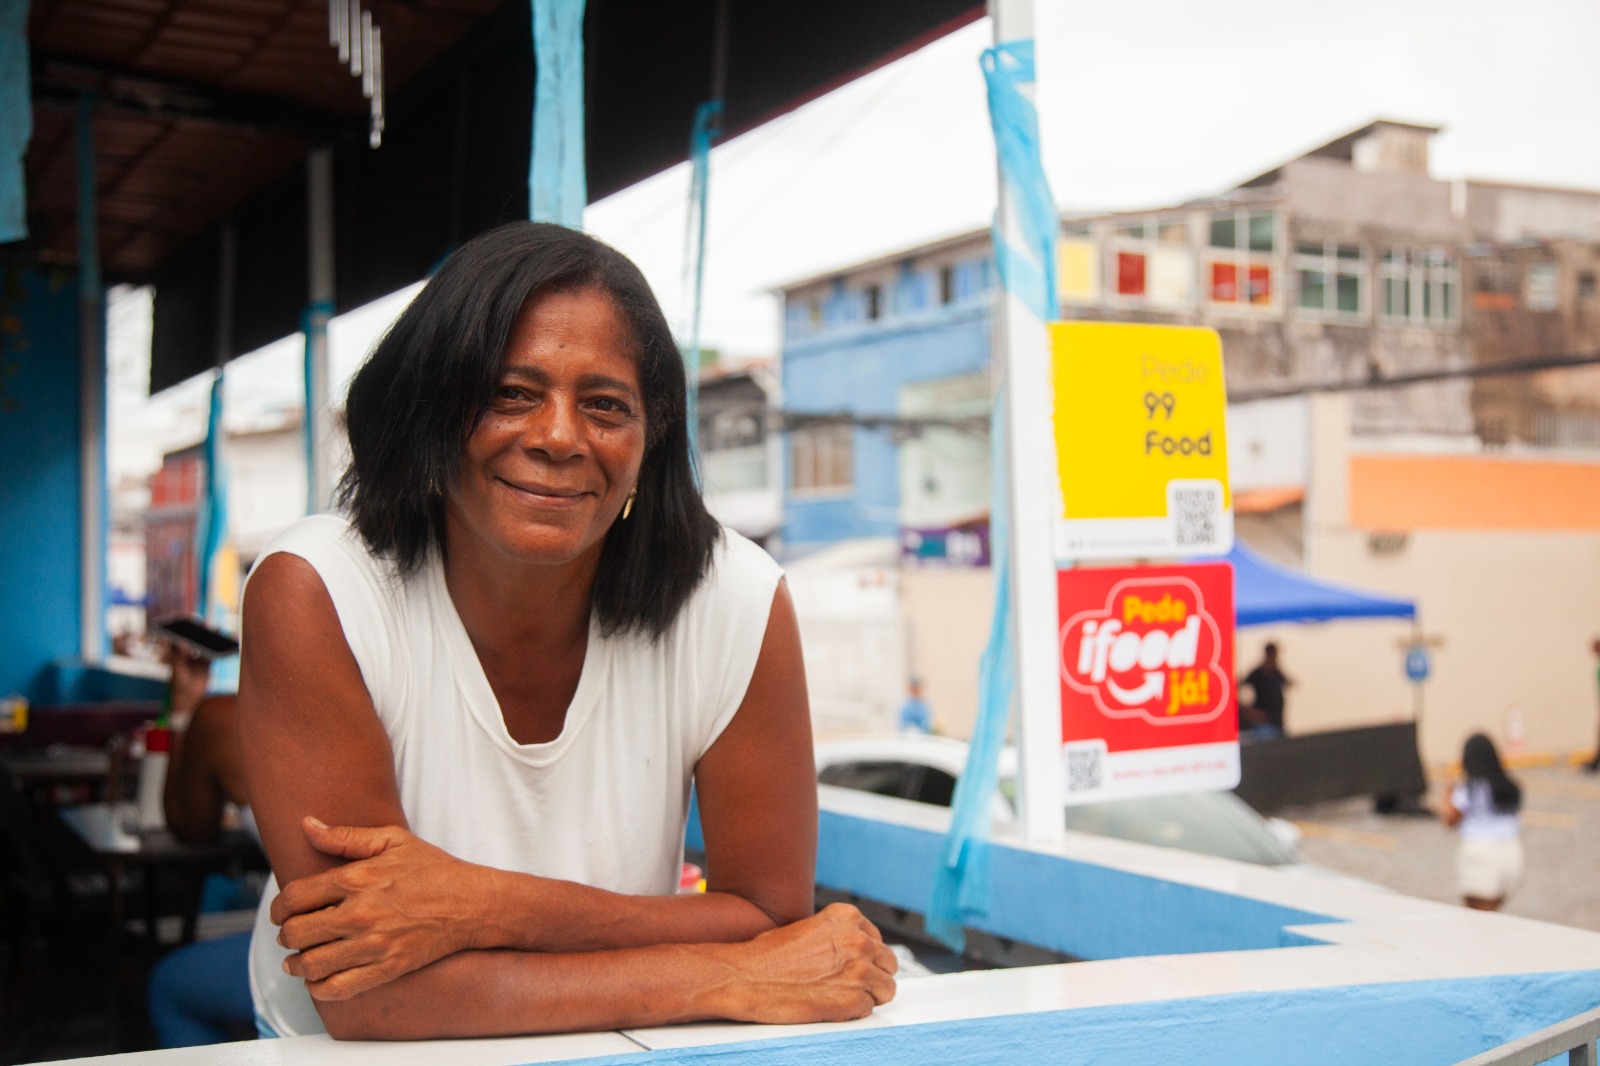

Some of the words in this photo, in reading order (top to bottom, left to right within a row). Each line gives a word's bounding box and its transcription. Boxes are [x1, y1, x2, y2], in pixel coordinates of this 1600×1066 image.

[1144, 392, 1175, 421] 99
[1145, 430, 1212, 457] Food
[1123, 593, 1186, 624] Pede
[1078, 615, 1201, 683] ifood
[1166, 670, 1209, 716] já!
